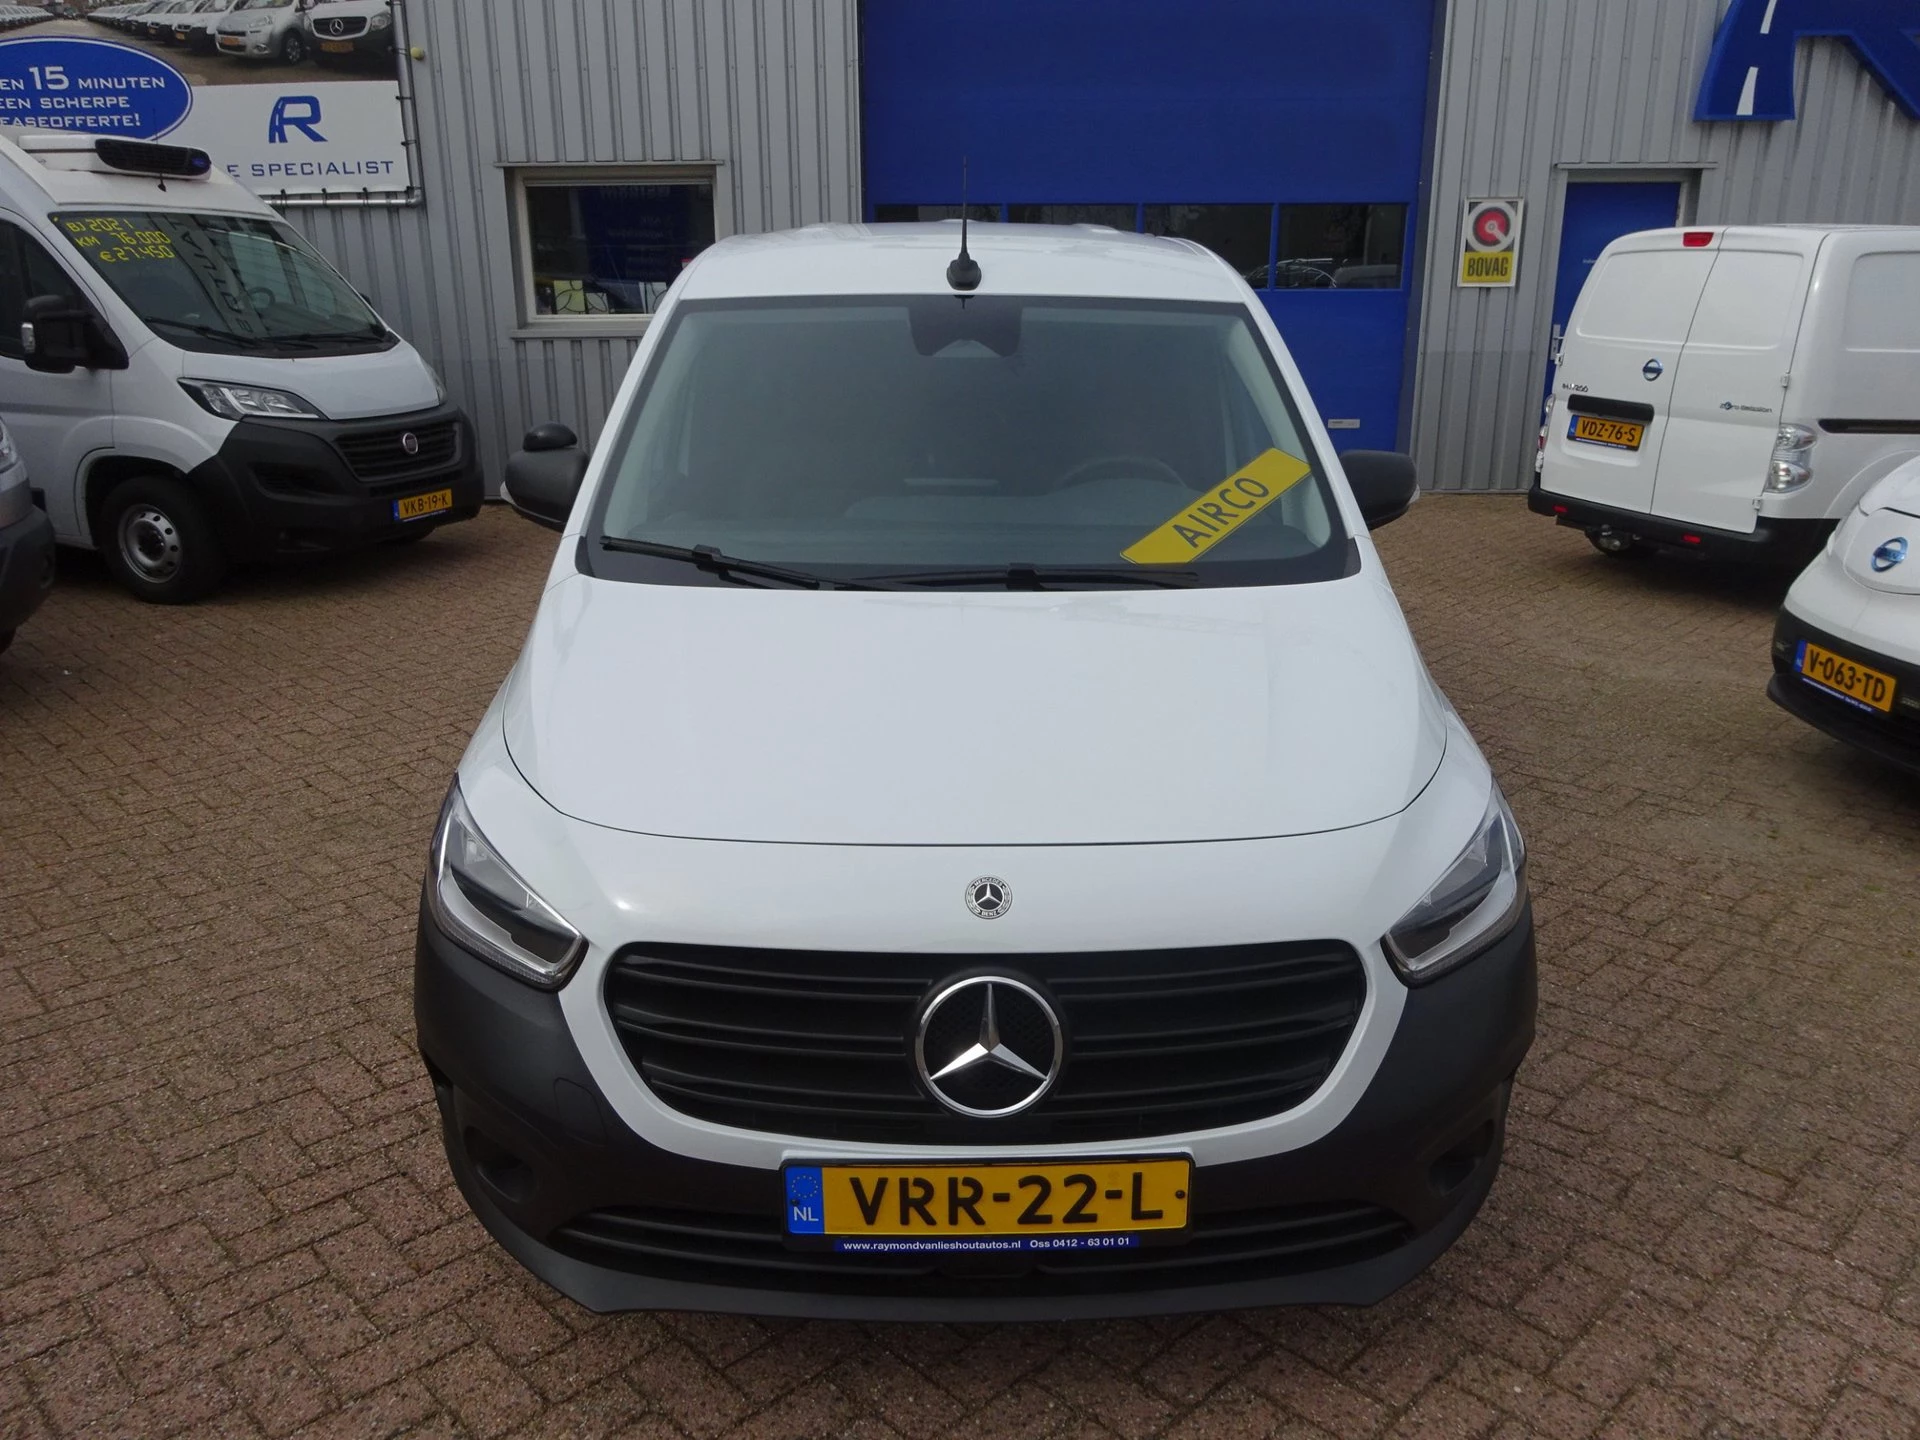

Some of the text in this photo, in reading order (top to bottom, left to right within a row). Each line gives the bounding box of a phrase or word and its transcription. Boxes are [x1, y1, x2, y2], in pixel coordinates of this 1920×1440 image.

[29, 66, 70, 91] 15
[78, 77, 166, 89] MINUTEN
[40, 96, 130, 109] SCHERPE
[252, 161, 394, 176] SPECIALIST
[85, 218, 134, 231] 2021
[75, 235, 101, 247] KM
[1467, 257, 1509, 277] BOVAG
[1582, 420, 1636, 442] VDZ-76-S
[404, 491, 448, 514] VKB-19-K
[1172, 477, 1270, 549] AIRCO
[1809, 649, 1886, 702] V-063-TD
[793, 1172, 1164, 1227] NL VRR-22-L
[843, 1240, 1021, 1251] www.raymondvanlieshoutautos.nl
[1029, 1239, 1050, 1248] Oss
[1053, 1238, 1078, 1248] 0412
[1087, 1238, 1100, 1247] 63
[1102, 1238, 1114, 1247] 01
[1117, 1237, 1129, 1246] 01
